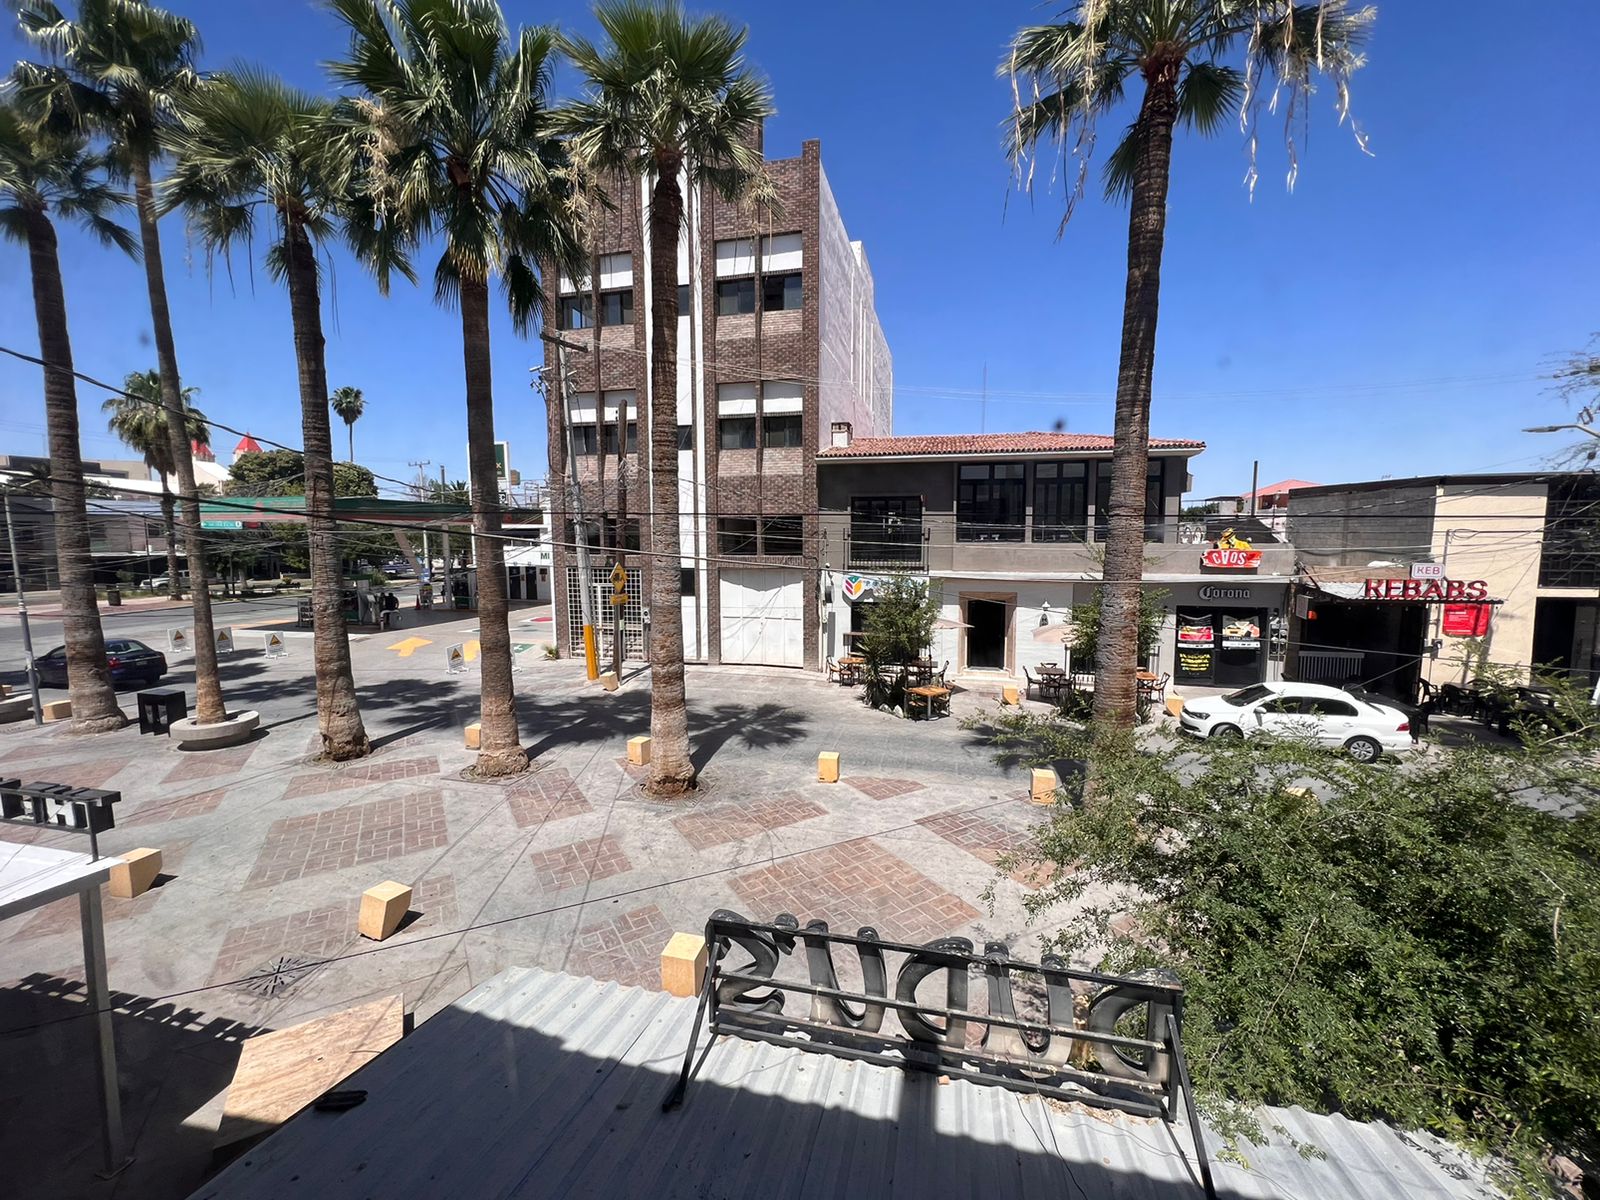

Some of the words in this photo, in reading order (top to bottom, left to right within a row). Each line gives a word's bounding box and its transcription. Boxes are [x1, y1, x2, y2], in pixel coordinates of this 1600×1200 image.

[1416, 566, 1441, 575] KEB
[1199, 586, 1250, 600] Corona
[1365, 578, 1488, 600] KEBABS
